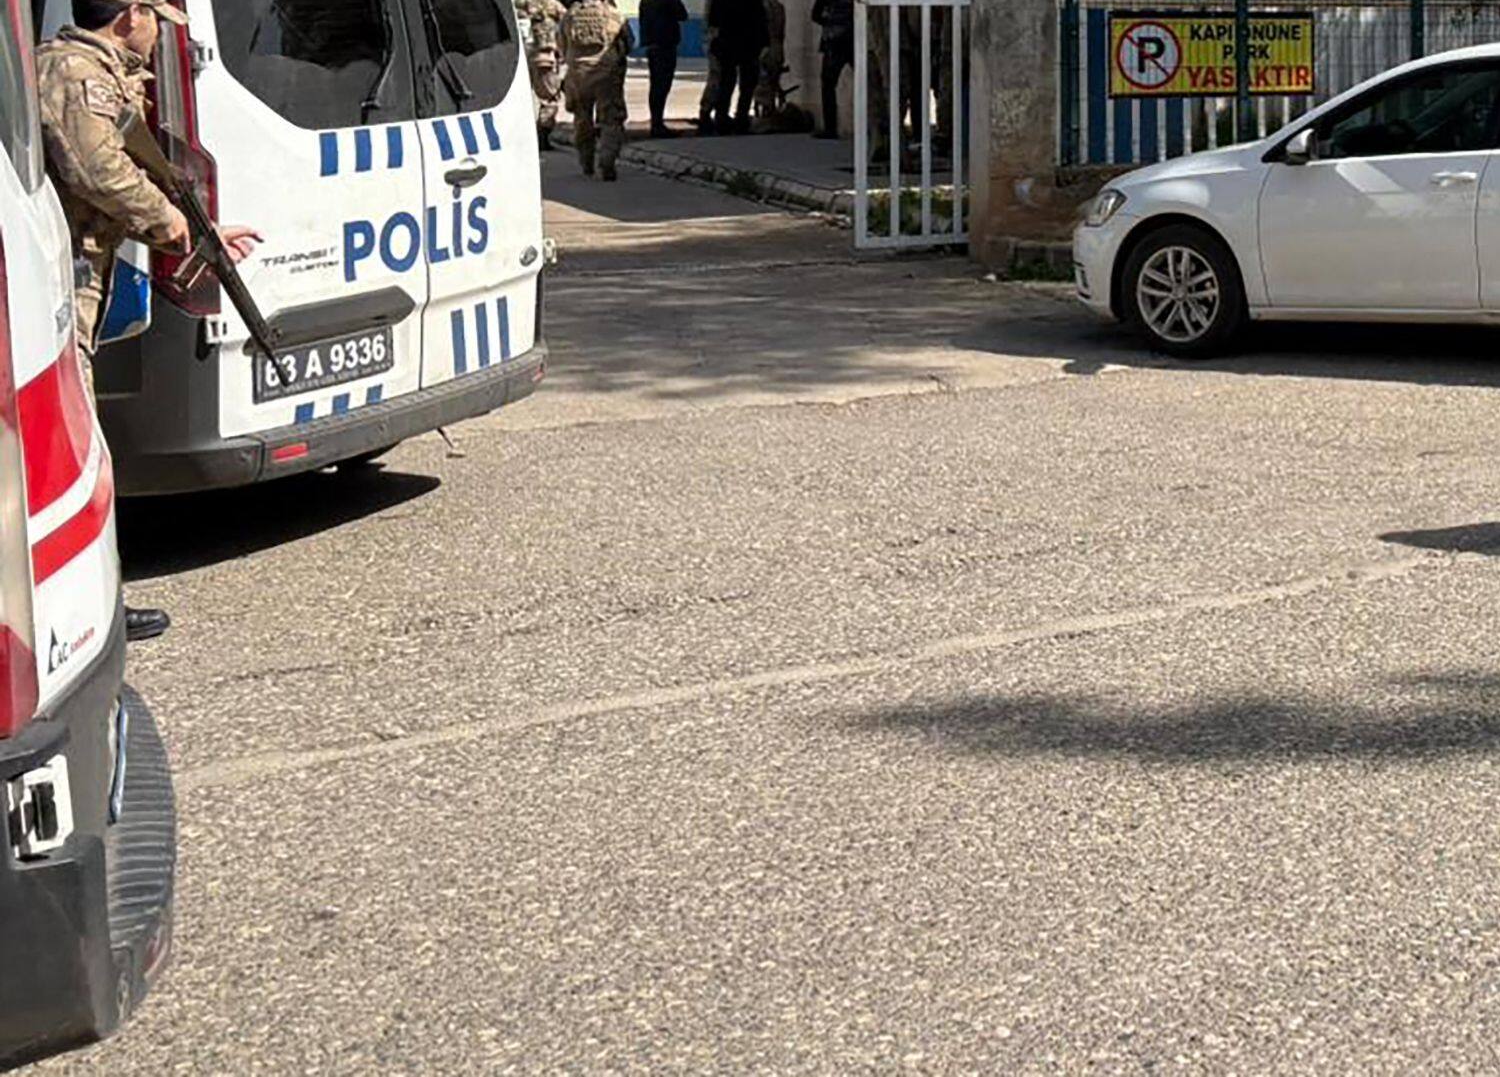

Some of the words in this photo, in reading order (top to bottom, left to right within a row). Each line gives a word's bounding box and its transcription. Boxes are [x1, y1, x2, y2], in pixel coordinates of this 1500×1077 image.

[1190, 24, 1232, 41] KAPI
[1223, 44, 1271, 60] PRK
[1187, 65, 1309, 88] YASKTIR
[343, 183, 488, 283] POLİS
[305, 349, 323, 379] A
[330, 334, 386, 373] 9336
